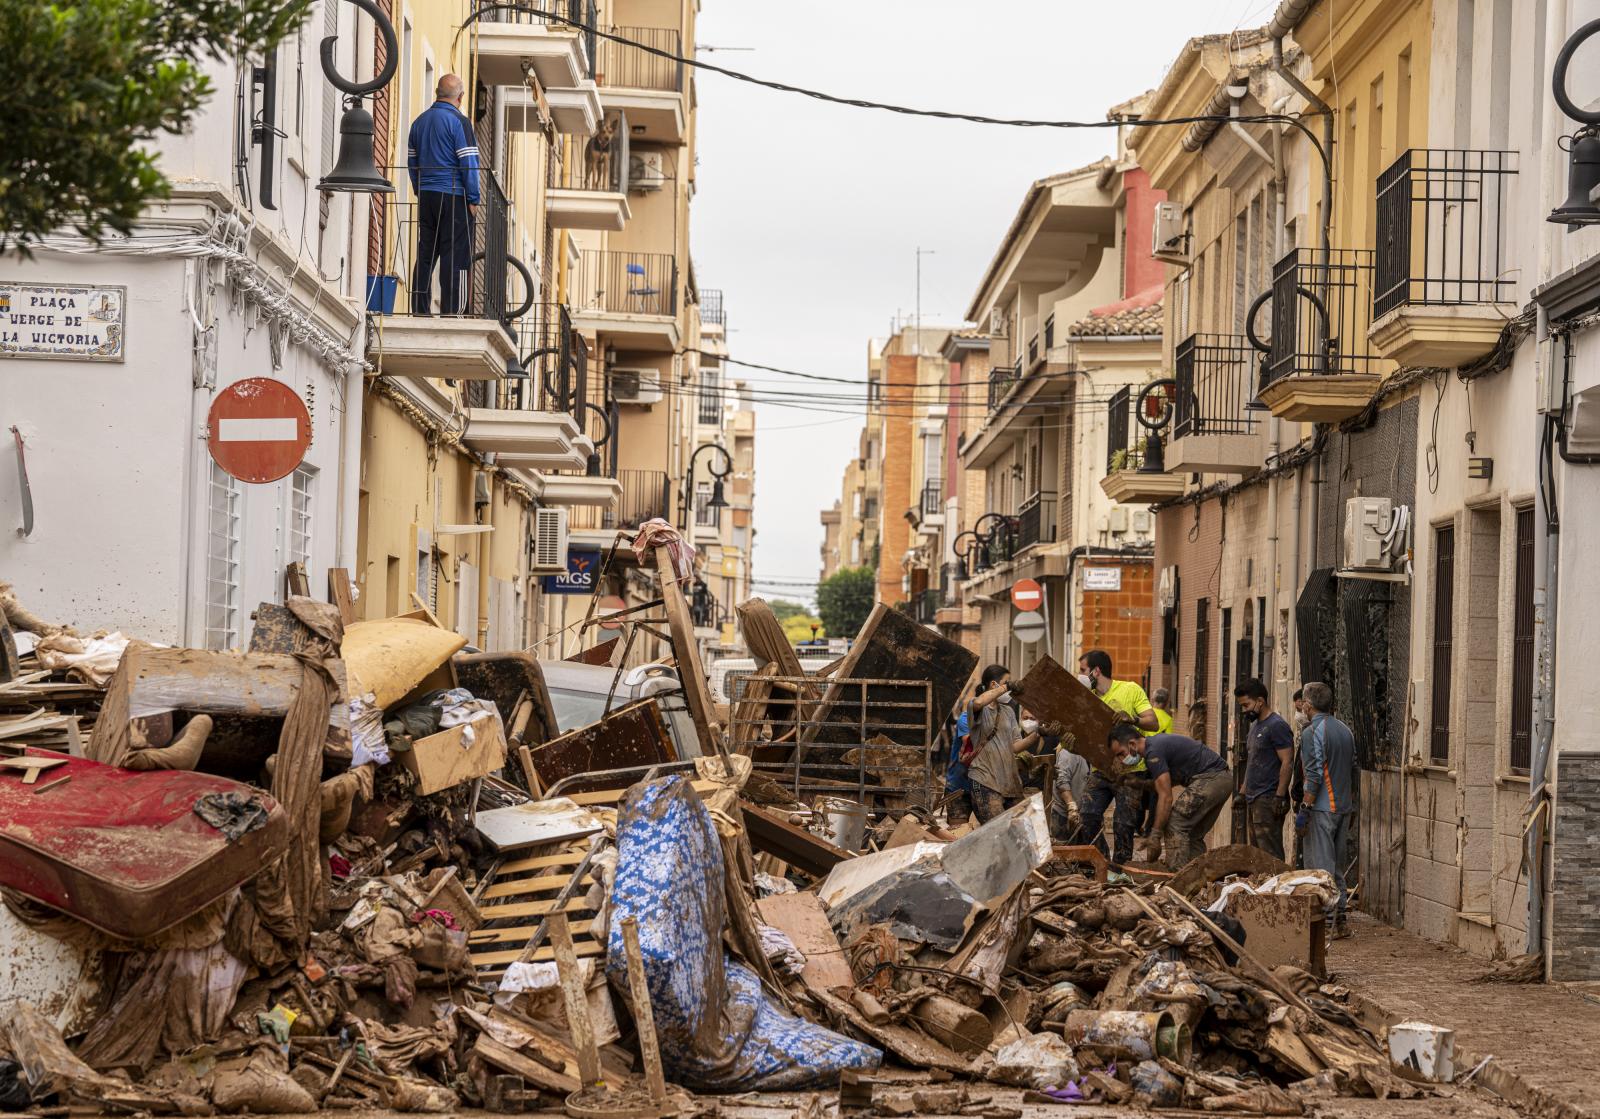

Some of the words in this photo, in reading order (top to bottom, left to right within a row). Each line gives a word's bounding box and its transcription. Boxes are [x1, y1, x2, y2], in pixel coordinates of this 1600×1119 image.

[30, 296, 75, 310] PLAÇA
[65, 316, 82, 327] DE
[2, 331, 19, 343] LA
[556, 572, 592, 585] MGS
